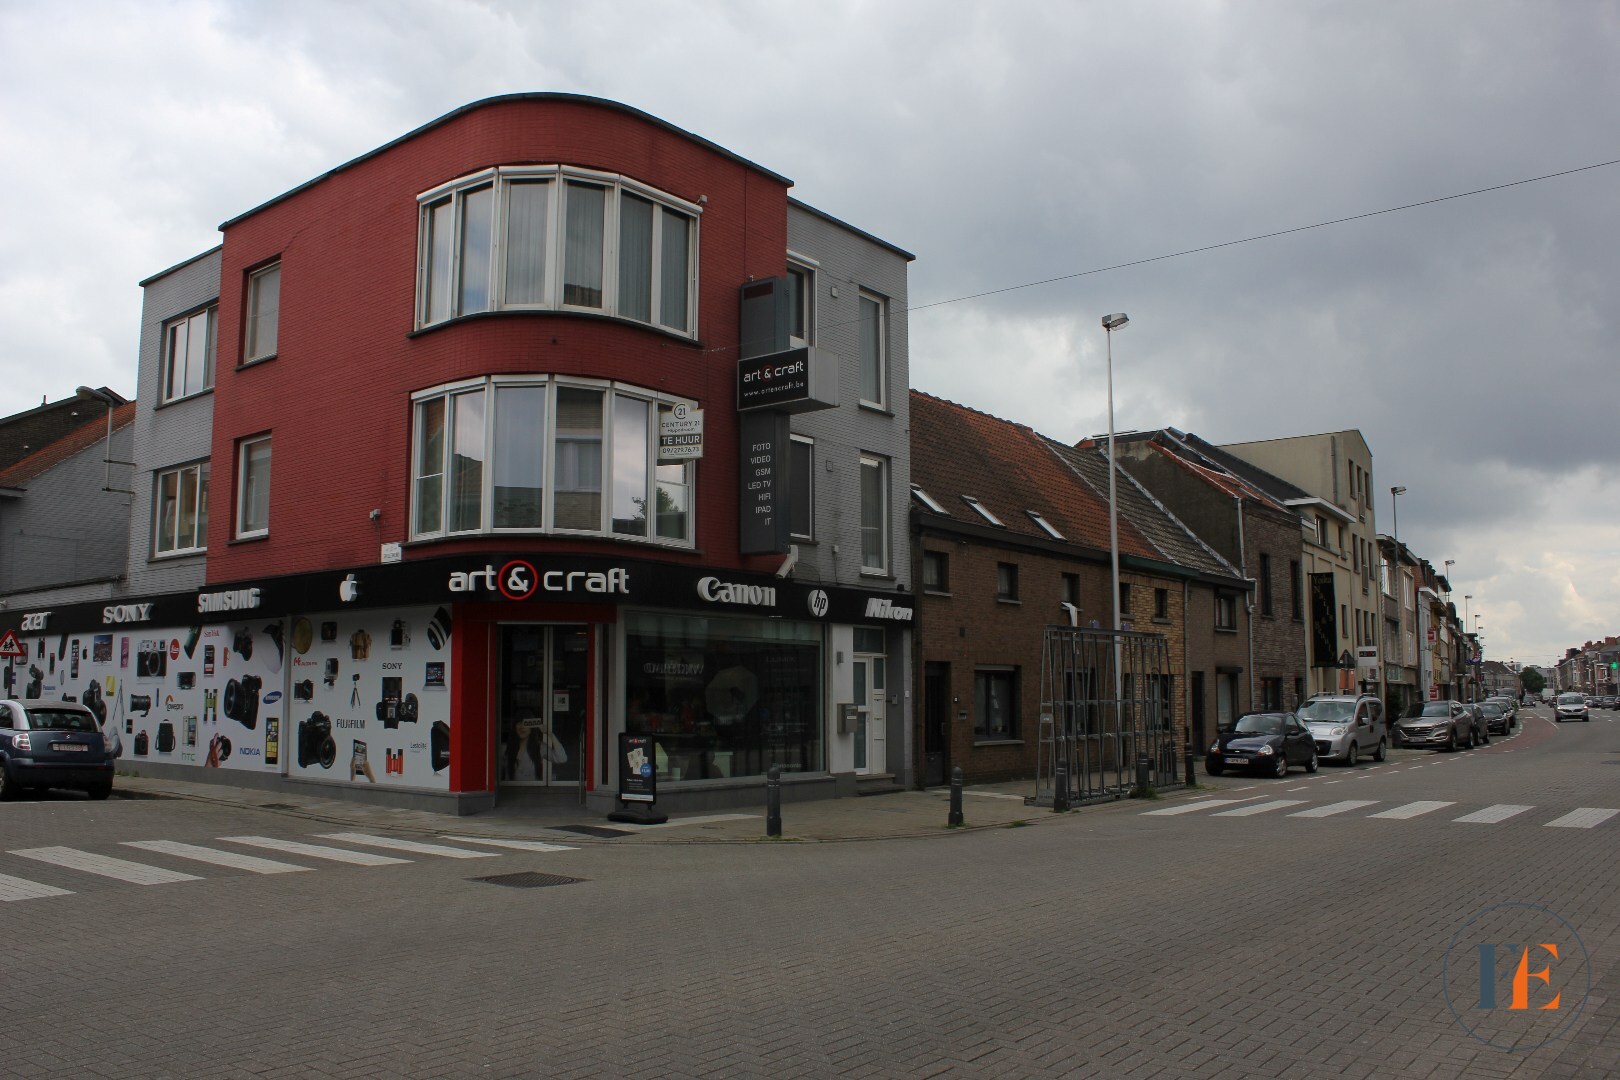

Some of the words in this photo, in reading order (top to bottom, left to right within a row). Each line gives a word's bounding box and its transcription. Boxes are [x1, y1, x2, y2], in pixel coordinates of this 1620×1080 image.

[744, 369, 761, 382] art
[764, 368, 771, 379] &
[774, 361, 804, 376] craft
[662, 436, 673, 445] TE
[675, 435, 700, 444] HUUR
[752, 442, 771, 452] FOTO
[750, 454, 771, 464] VIDEO
[755, 467, 771, 477] GSM
[747, 481, 762, 490] LED
[763, 480, 772, 488] TV
[758, 492, 771, 501] HIFI
[755, 505, 771, 514] IPAD
[764, 517, 772, 526] IT
[448, 564, 497, 592] art
[507, 566, 529, 593] &
[543, 567, 630, 594] craft
[697, 576, 776, 606] Canon
[197, 588, 261, 613] SAMSUNG
[102, 603, 153, 624] SONY
[864, 597, 913, 621] Nikon
[21, 611, 52, 631] acer
[382, 662, 403, 670] SONY
[336, 718, 366, 729] FUJIFILM
[239, 747, 261, 756] NOKIA
